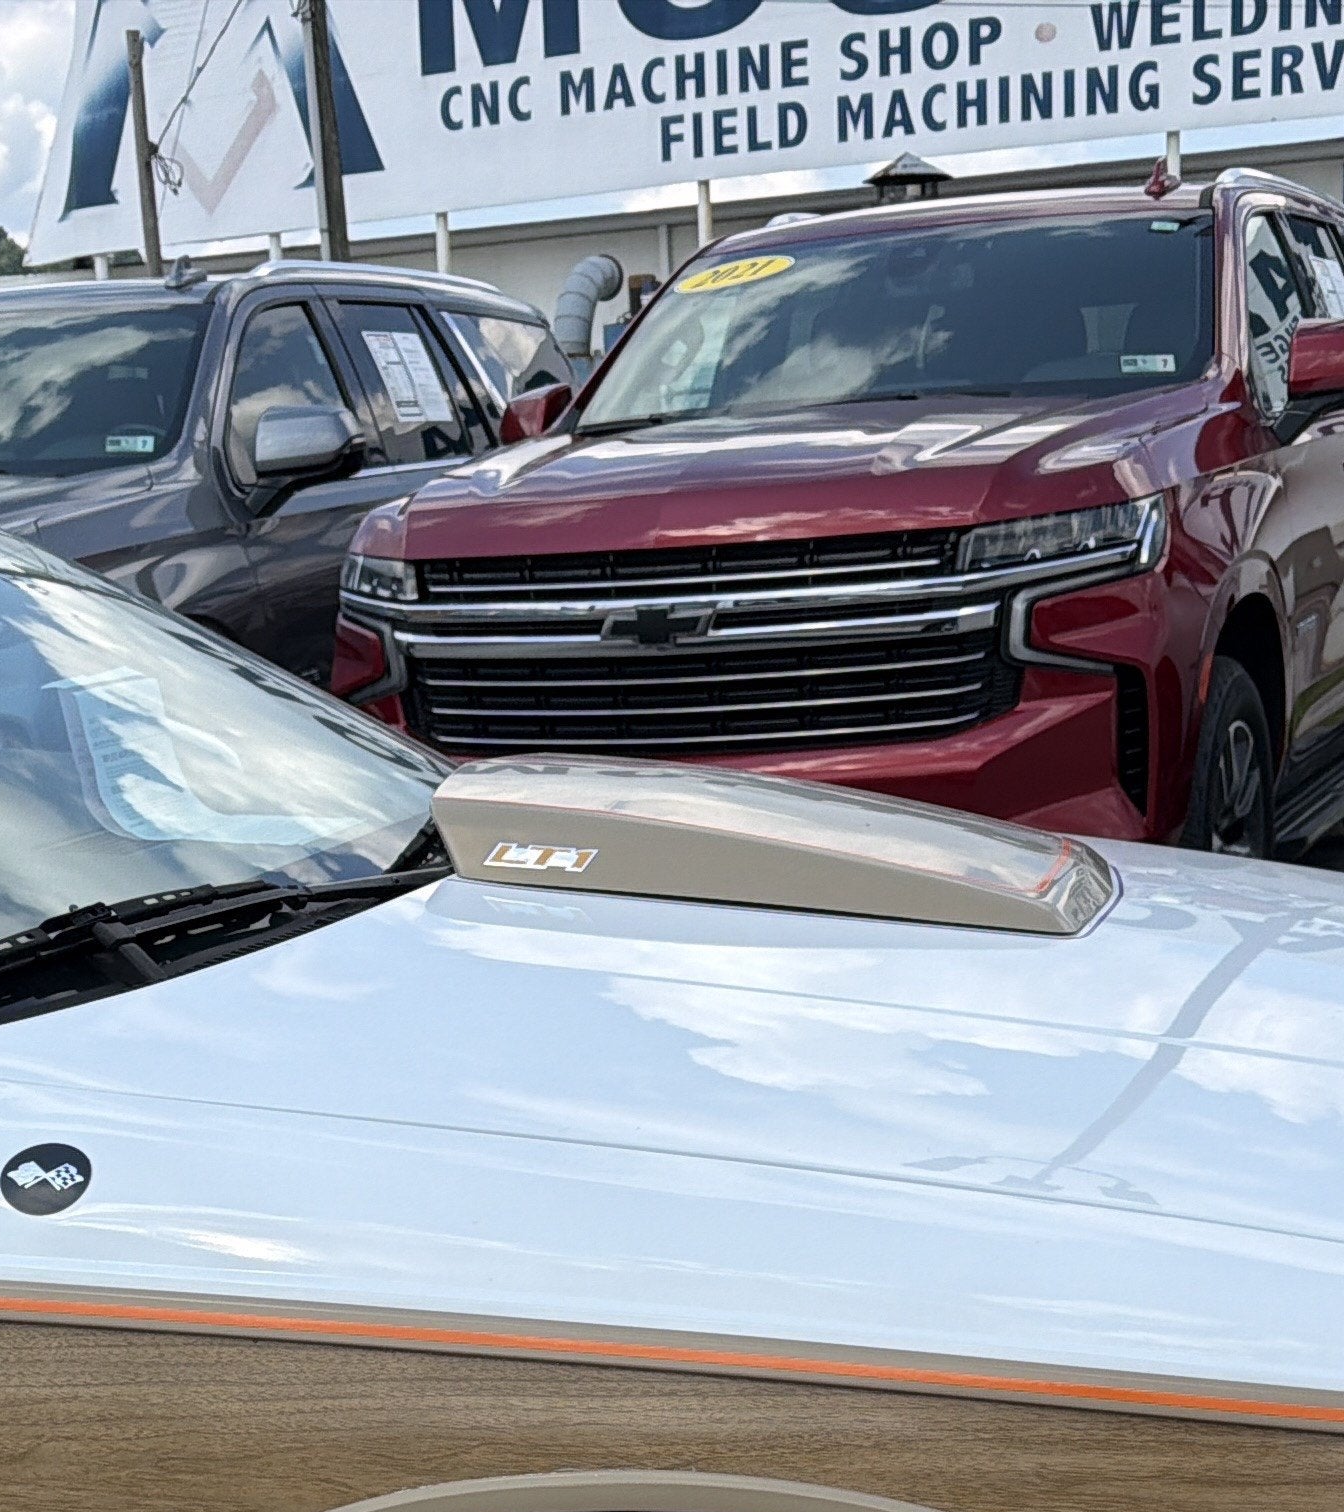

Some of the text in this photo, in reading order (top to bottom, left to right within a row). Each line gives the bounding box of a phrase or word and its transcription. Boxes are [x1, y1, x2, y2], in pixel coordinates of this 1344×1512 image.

[440, 75, 532, 131] CNC
[559, 38, 810, 117] MACHINE
[839, 15, 1003, 81] SHOP
[660, 100, 809, 162] FIELD
[836, 60, 1160, 143] MACHINING
[689, 259, 776, 289] 2021
[483, 841, 600, 873] LT1
